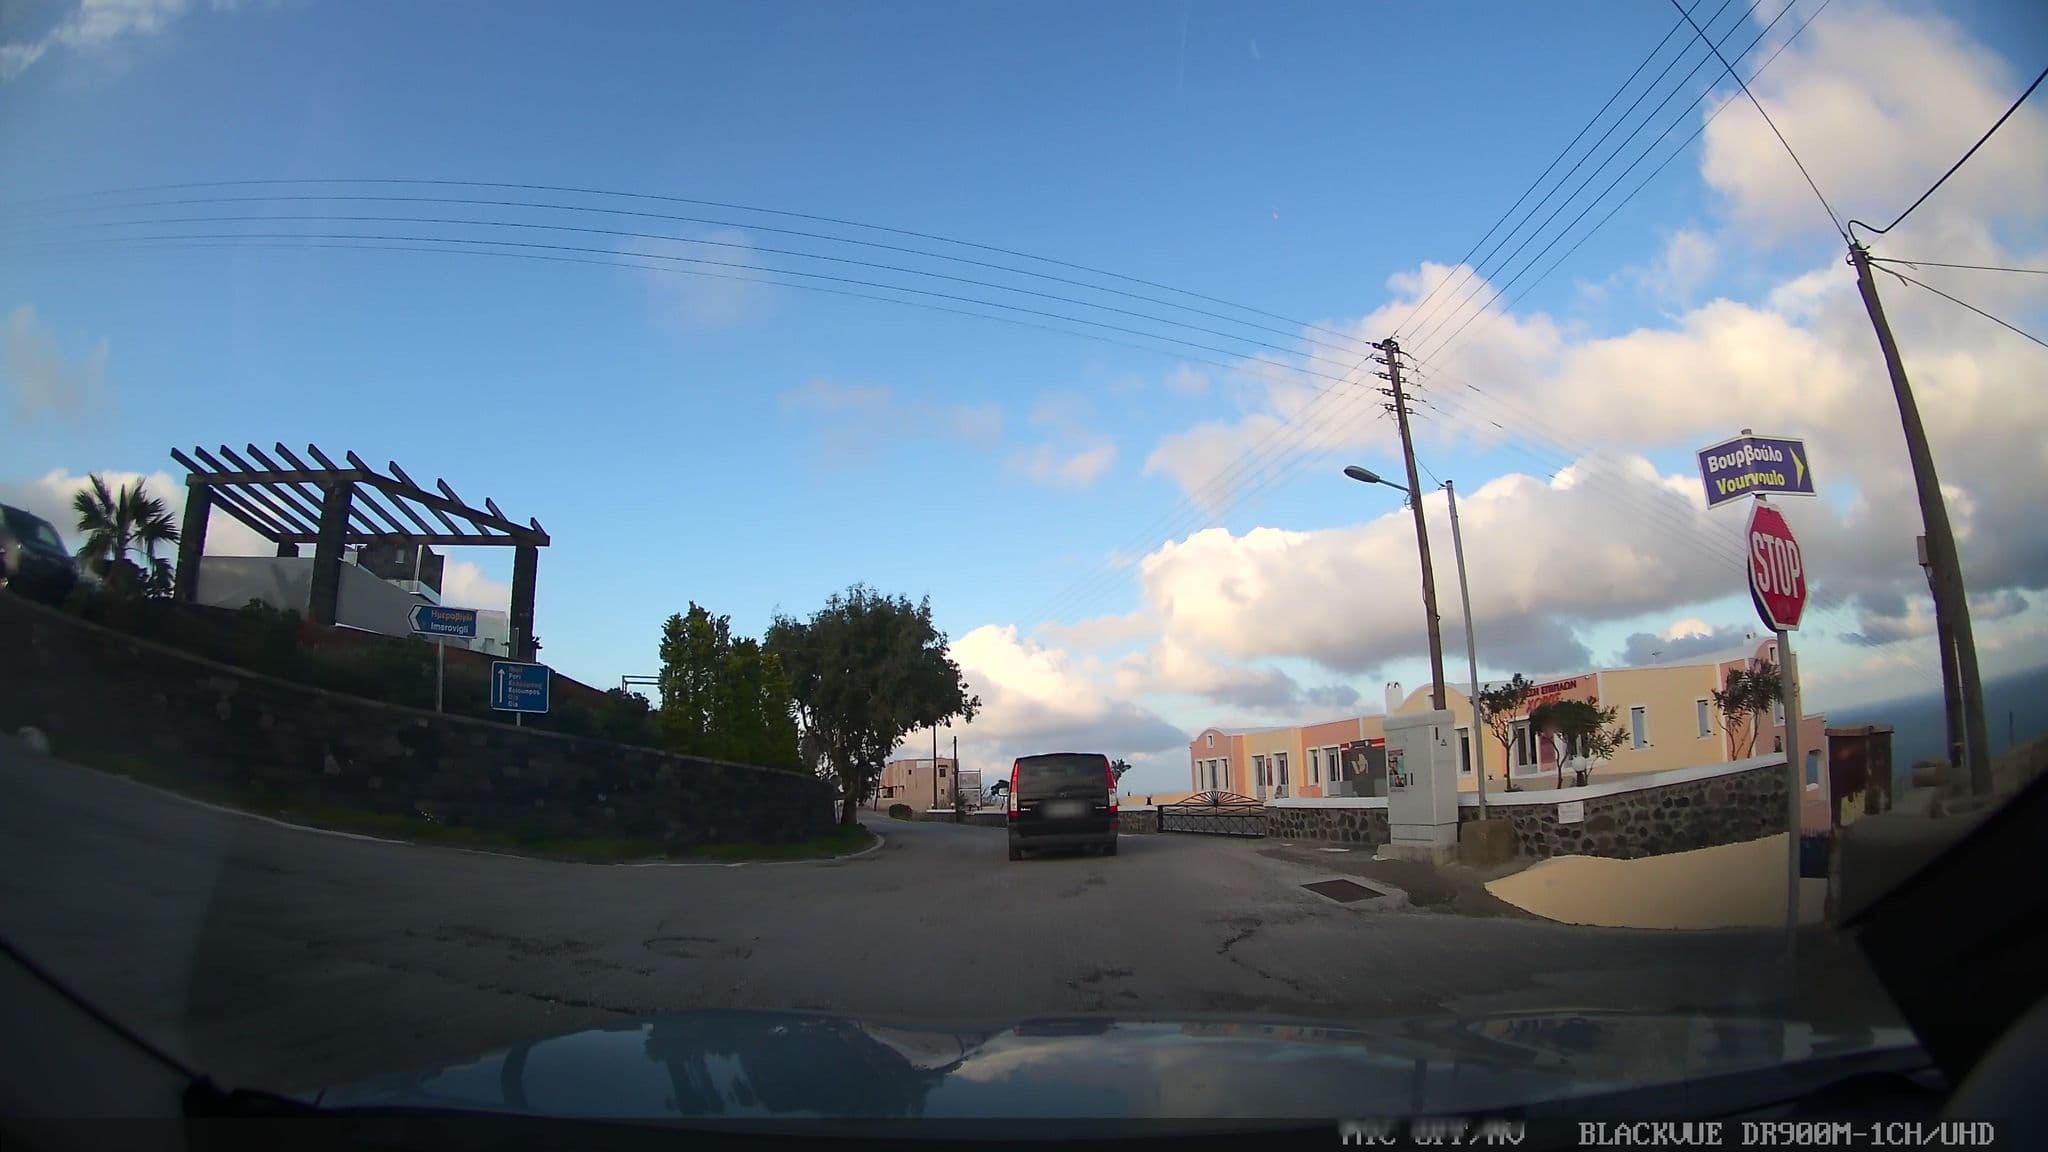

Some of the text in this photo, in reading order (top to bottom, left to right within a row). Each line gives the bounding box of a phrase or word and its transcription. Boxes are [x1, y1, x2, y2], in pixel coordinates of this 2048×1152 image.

[1707, 444, 1783, 473] Βουρβούλο
[1752, 531, 1800, 598] STOP
[431, 621, 469, 635] Imerovigli
